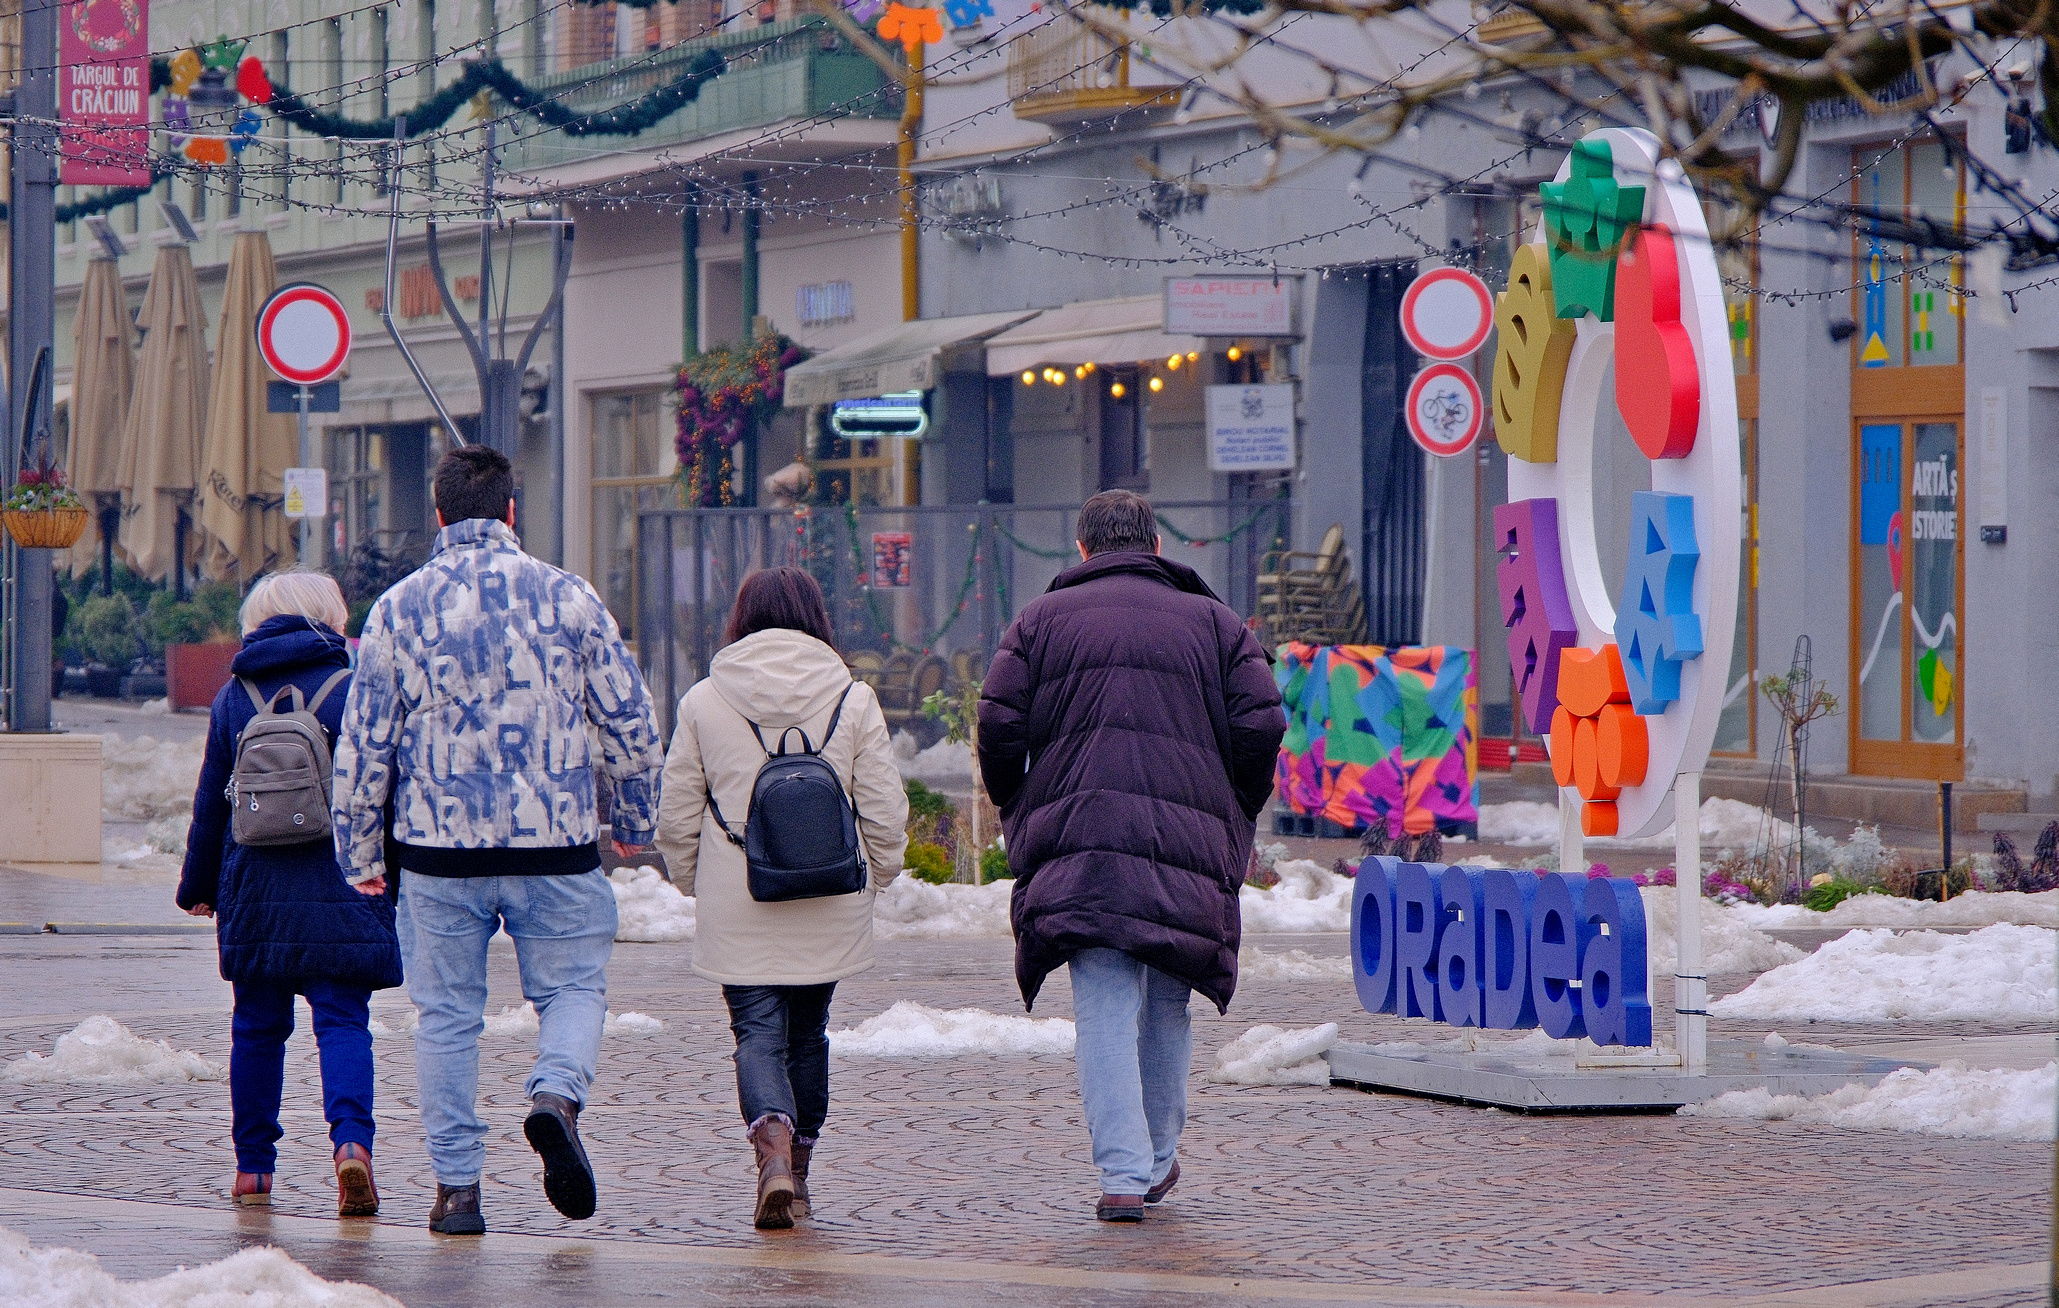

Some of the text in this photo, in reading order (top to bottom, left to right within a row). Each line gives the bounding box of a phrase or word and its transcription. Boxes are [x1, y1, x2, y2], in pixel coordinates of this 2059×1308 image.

[123, 66, 140, 86] DE
[71, 85, 140, 115] CRĂCIUN
[1912, 453, 1949, 497] ARTĂ
[1911, 510, 1958, 540] ISTORIE
